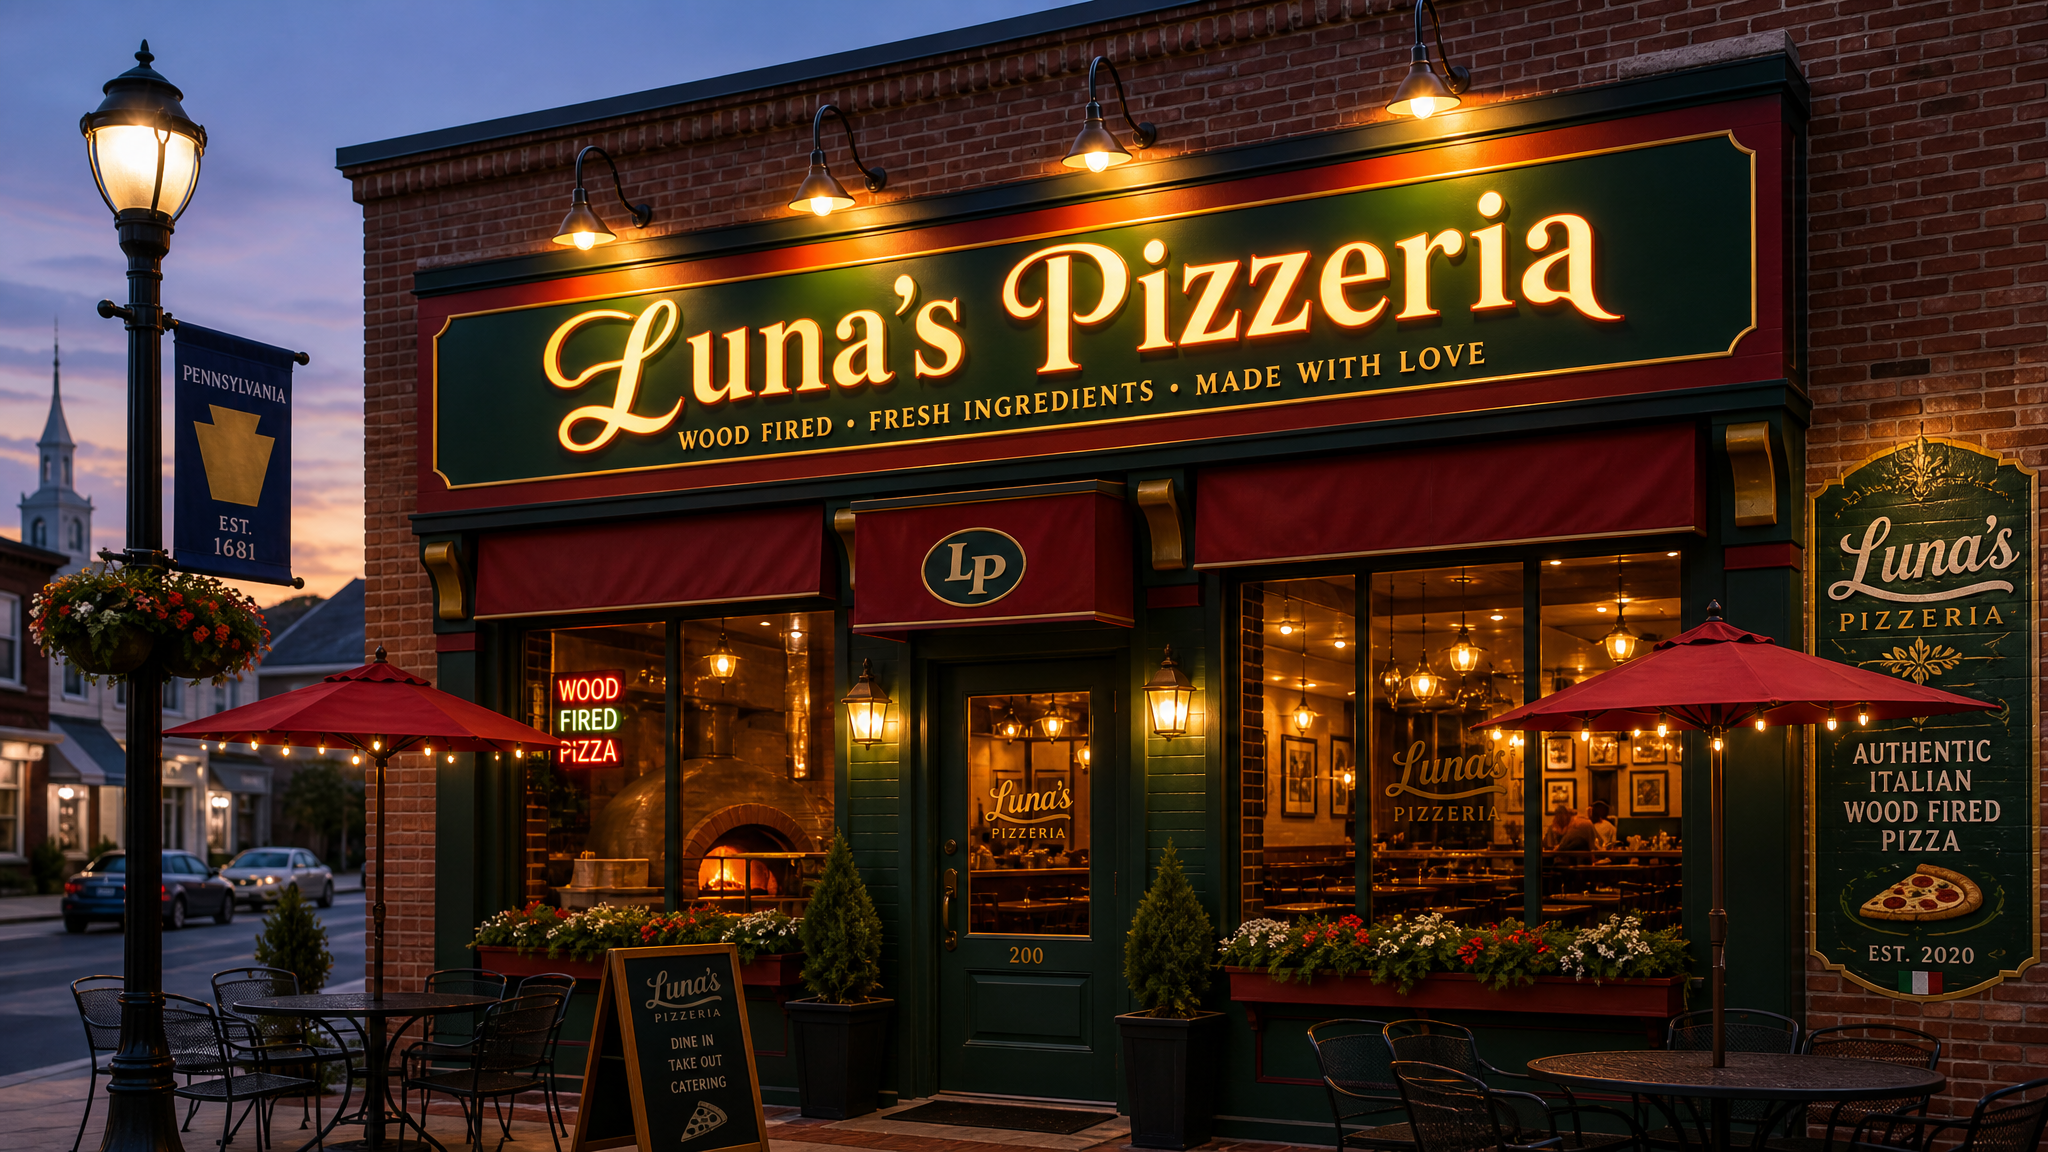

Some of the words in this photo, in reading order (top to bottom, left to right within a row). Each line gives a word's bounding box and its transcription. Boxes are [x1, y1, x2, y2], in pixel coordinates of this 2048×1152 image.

[543, 273, 966, 454] Luna's
[1003, 190, 1625, 374] Pizzeria
[183, 364, 286, 404] PENNSYLVANIA
[678, 428, 751, 451] WOOD
[761, 416, 833, 443] FIRED
[869, 405, 951, 432] FRESH
[963, 380, 1155, 423] INGREDIENTS
[1195, 364, 1282, 397] MADE
[1296, 354, 1382, 382] WITH
[1399, 341, 1487, 374] LOVE
[218, 515, 253, 536] EST.
[213, 536, 257, 562] 1681
[1827, 514, 2021, 602] Luna's
[944, 542, 1007, 596] LP
[1838, 604, 2005, 633] PIZZERIA
[559, 677, 619, 701] WOOD
[560, 708, 618, 731] FIRED
[560, 739, 617, 762] PIZZA
[1852, 738, 1992, 765] AUTHENTIC
[1869, 769, 1972, 793] ITALIAN
[985, 779, 1074, 824] Luna's
[1843, 800, 1919, 824] WOOD
[1927, 800, 2001, 823] FIRED
[1394, 806, 1502, 822] PIZZERIA
[991, 826, 1066, 840] PIZZERIA
[1881, 829, 1961, 852] PIZZA
[1009, 946, 1044, 964] 200
[1868, 944, 1911, 963] EST.
[1921, 946, 1975, 965] 2020
[646, 967, 722, 1009] Luna's
[655, 1009, 721, 1023] PIZZERIA
[671, 1035, 698, 1049] DINE
[702, 1034, 714, 1046] IN
[668, 1057, 697, 1071] TAKE
[701, 1054, 722, 1068] OUT
[671, 1076, 727, 1094] CATERING
